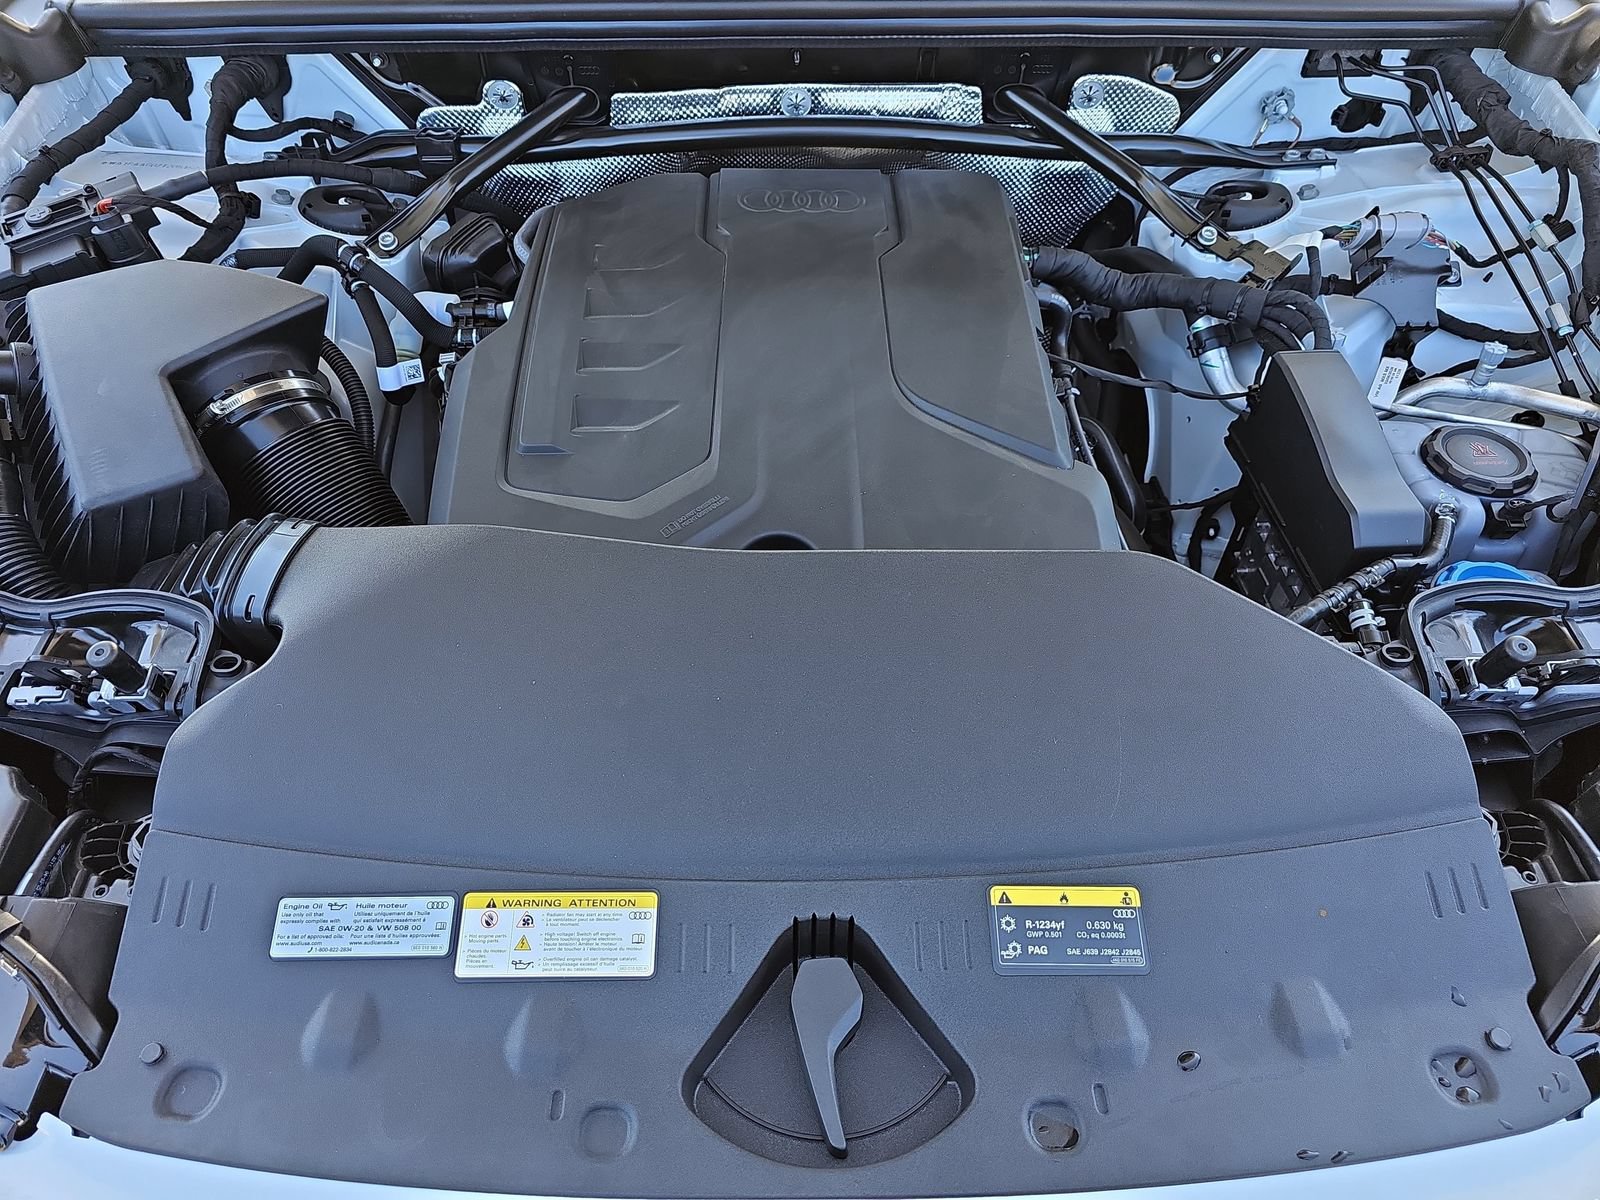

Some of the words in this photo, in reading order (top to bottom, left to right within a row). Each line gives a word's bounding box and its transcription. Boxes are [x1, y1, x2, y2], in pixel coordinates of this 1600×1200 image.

[284, 903, 310, 911] Engine
[502, 898, 562, 908] WARNING
[569, 898, 636, 908] ATTENTION
[1025, 920, 1065, 930] R-1234yf
[1086, 921, 1110, 930] 0.630
[1112, 921, 1124, 931] kg
[1028, 946, 1048, 954] PAG
